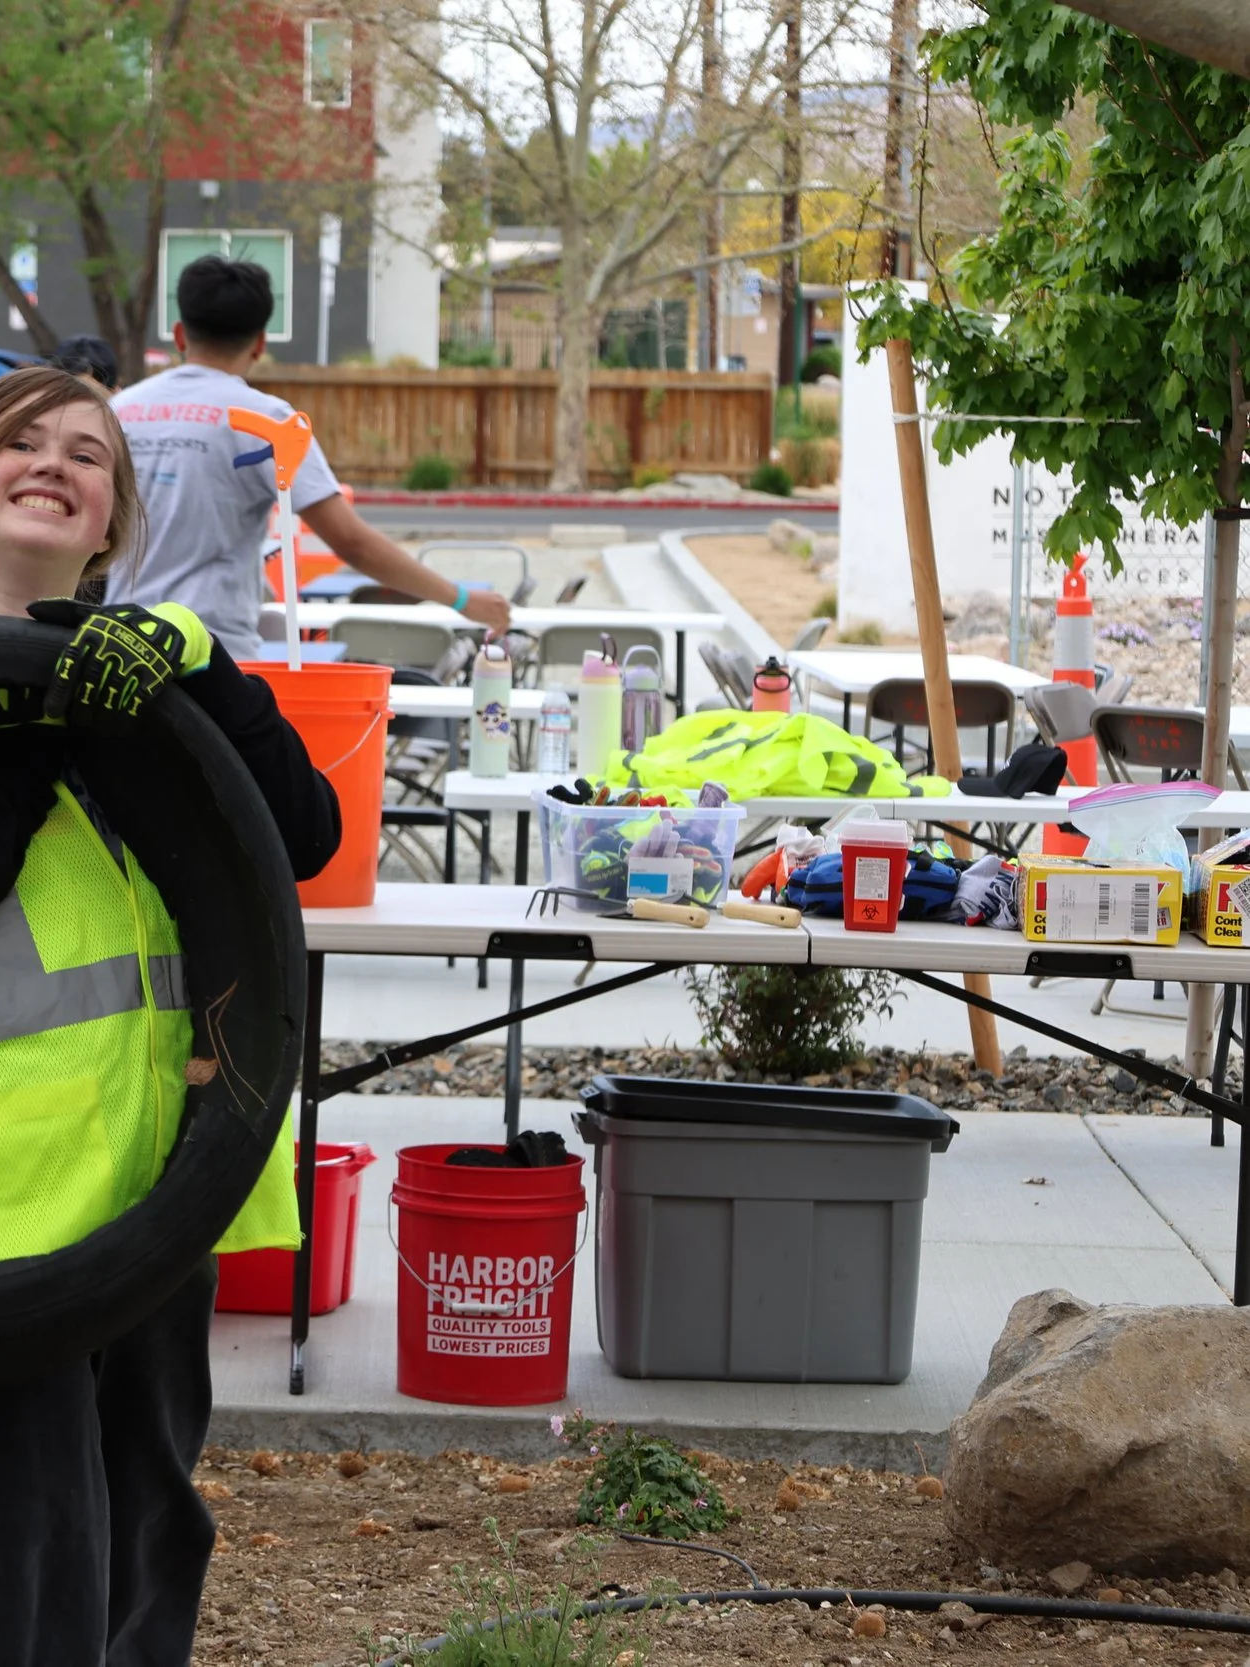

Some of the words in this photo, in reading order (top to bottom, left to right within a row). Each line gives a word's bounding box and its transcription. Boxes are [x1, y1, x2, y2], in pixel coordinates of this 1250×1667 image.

[1044, 567, 1190, 585] SRVICES
[1214, 927, 1243, 938] Clea
[427, 1251, 555, 1287] HARBOR
[427, 1282, 554, 1317] FREIGHT
[432, 1318, 497, 1334] QUALITY
[501, 1320, 547, 1334] TOOLS
[432, 1337, 491, 1354] LOWEST
[495, 1340, 546, 1355] PRICES
